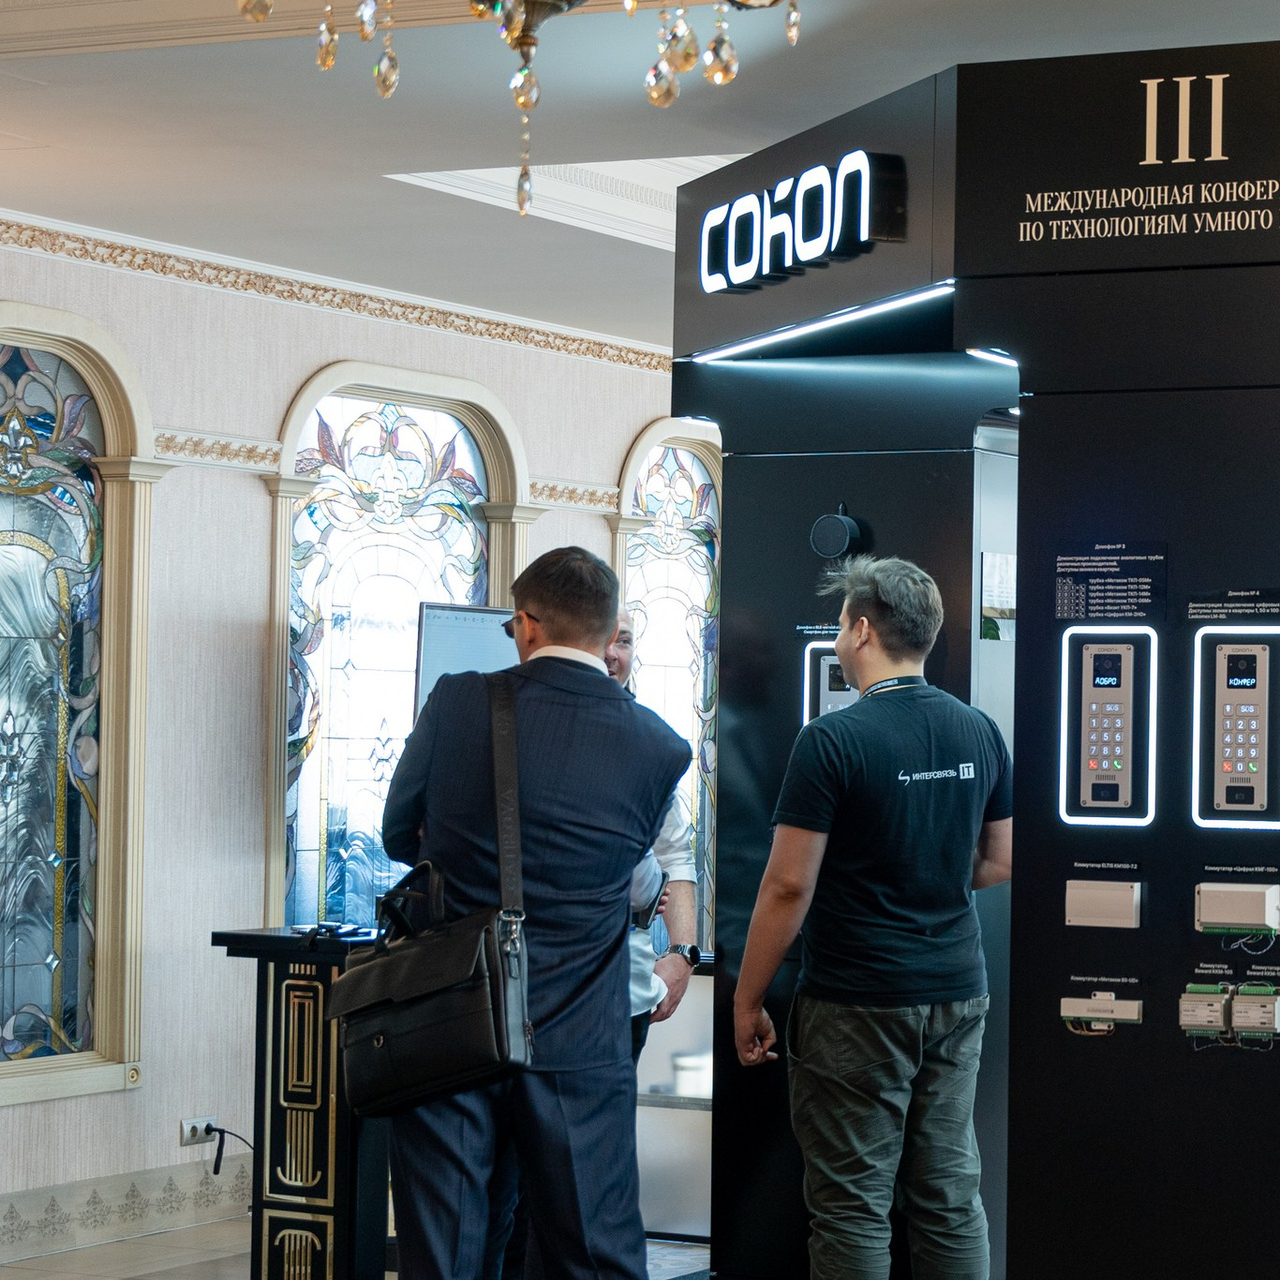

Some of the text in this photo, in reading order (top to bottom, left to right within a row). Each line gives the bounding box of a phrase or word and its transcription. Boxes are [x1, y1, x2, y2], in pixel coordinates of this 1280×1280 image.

[1139, 74, 1230, 165] III
[1026, 184, 1194, 213] МЕЖДУНАРОДНАЯ
[1019, 221, 1044, 242] ПО
[1049, 214, 1187, 240] ТЕХНОЛОГИЯМ
[1194, 209, 1273, 233] УМНОГО
[1115, 733, 1121, 741] 6
[1237, 749, 1243, 757] 8
[1250, 749, 1256, 757] 9
[1237, 763, 1243, 771] 0
[912, 769, 957, 781] ИНТЕРСВЯЗЬ
